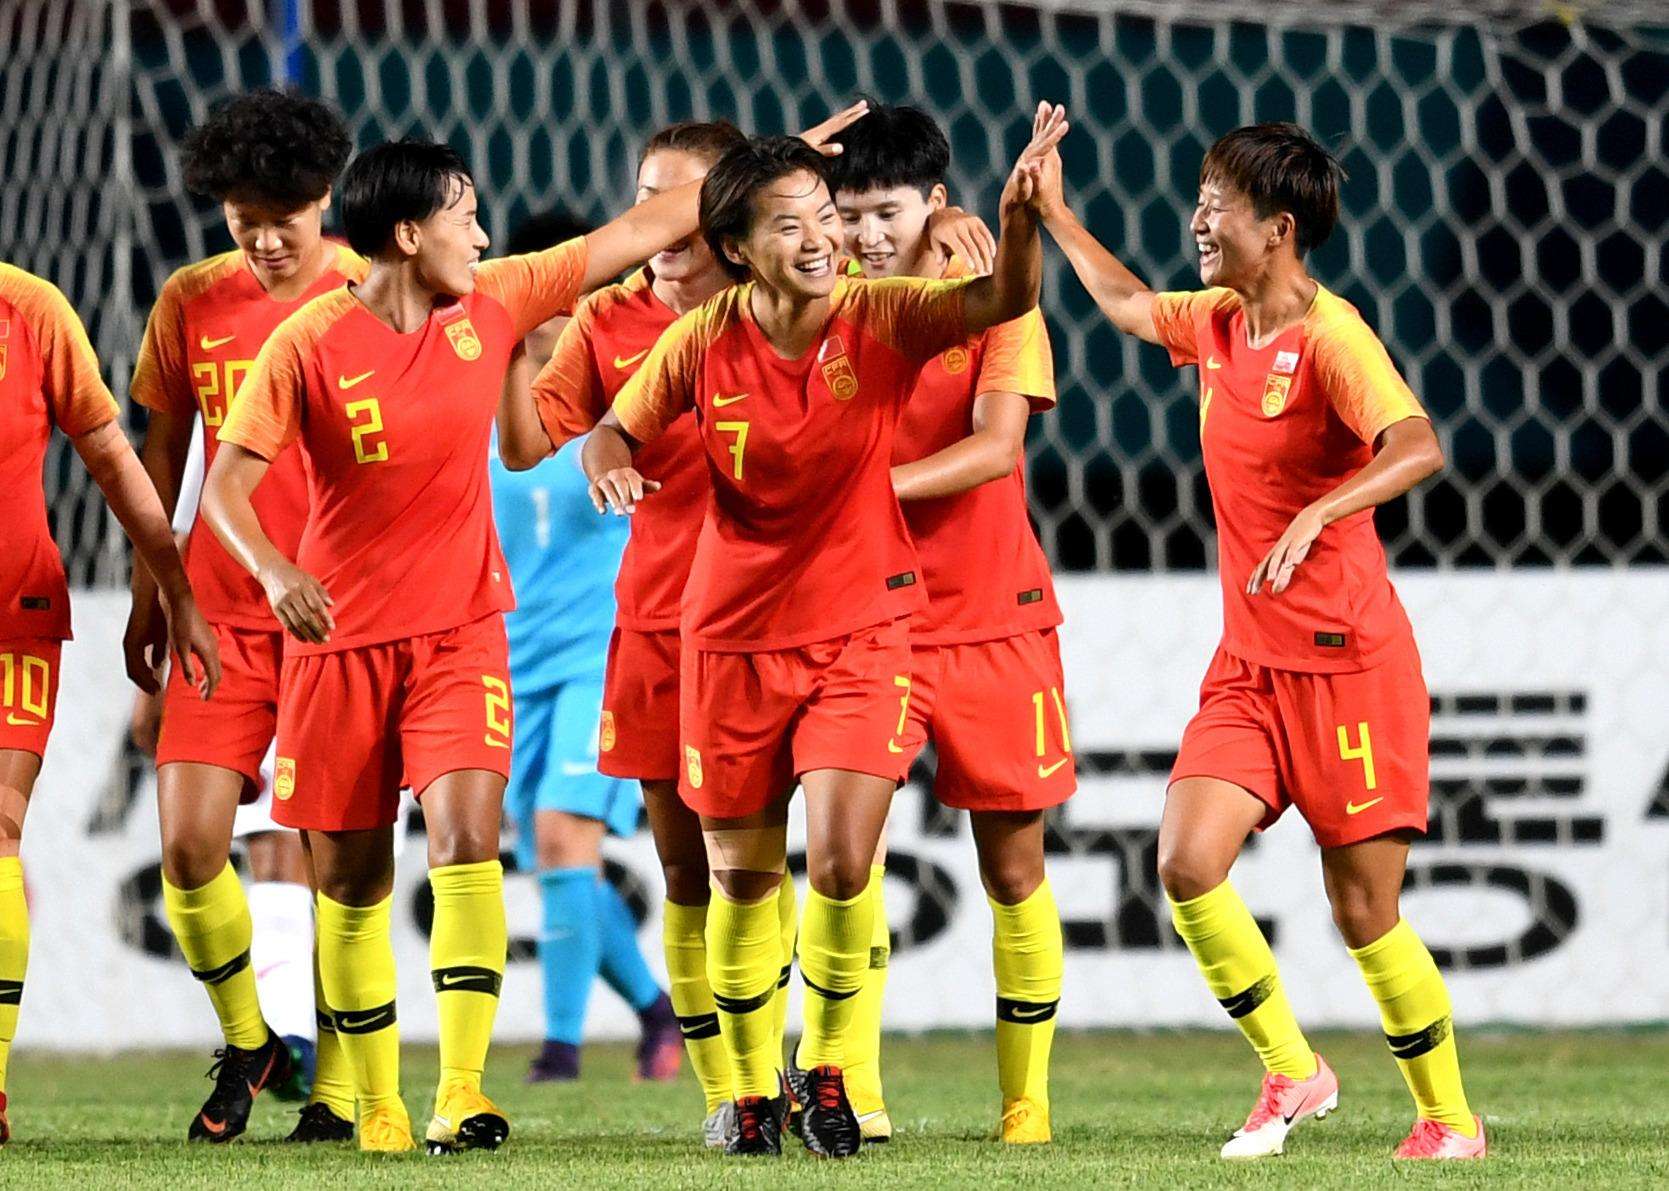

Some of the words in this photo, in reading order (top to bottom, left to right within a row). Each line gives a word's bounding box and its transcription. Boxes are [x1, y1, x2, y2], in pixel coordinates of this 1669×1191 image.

[345, 398, 388, 464] 2
[715, 421, 749, 480] 7
[531, 487, 550, 549] 1
[0, 653, 49, 719] 10
[481, 674, 509, 738] 2
[894, 675, 911, 736] 7
[1032, 686, 1071, 757] 11
[1336, 721, 1376, 790] 4
